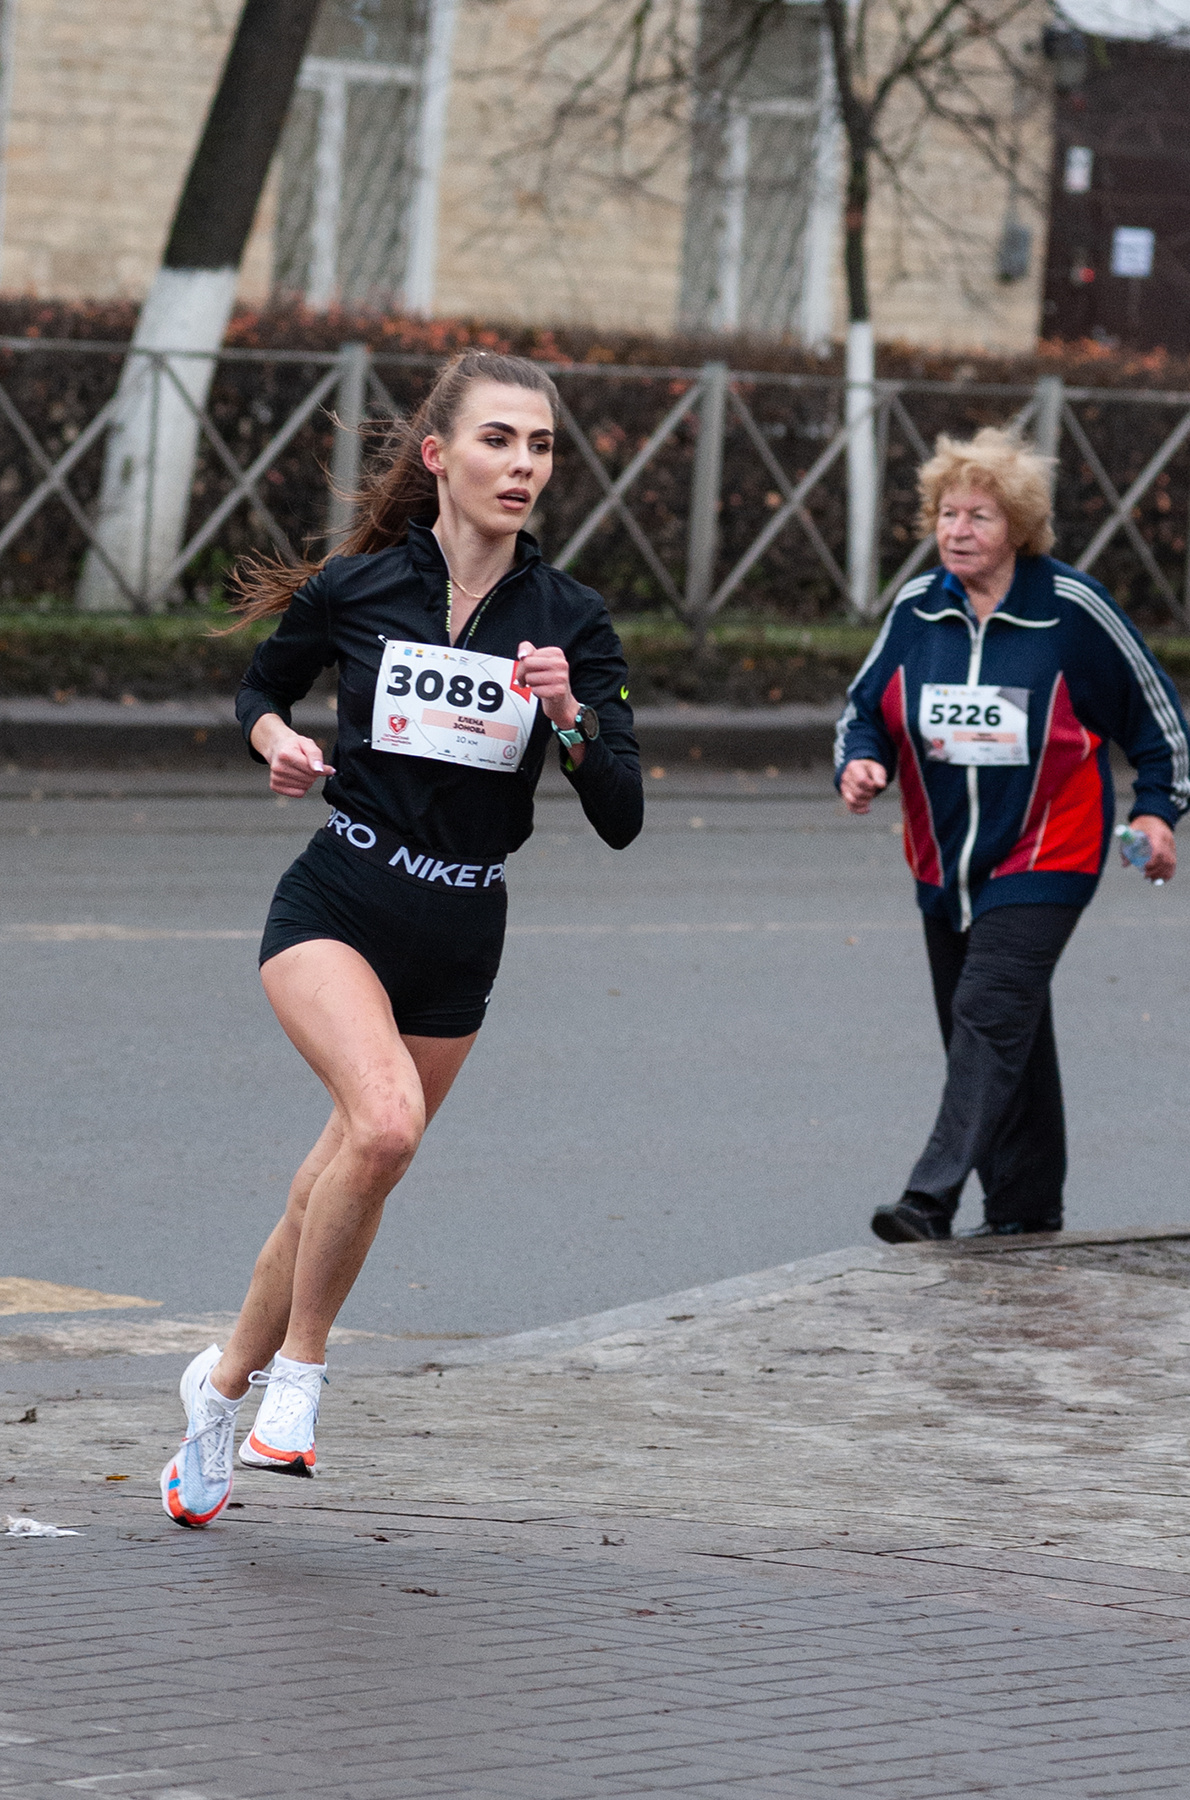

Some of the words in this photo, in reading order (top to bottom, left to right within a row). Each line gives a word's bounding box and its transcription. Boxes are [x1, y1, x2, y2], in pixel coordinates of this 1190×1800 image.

[386, 665, 504, 713] 3089
[457, 716, 484, 727] ЕЛЕНА
[929, 704, 1001, 726] 5226
[453, 722, 486, 735] ЗОНОВА
[456, 735, 467, 744] 10
[388, 846, 482, 887] NIKE
